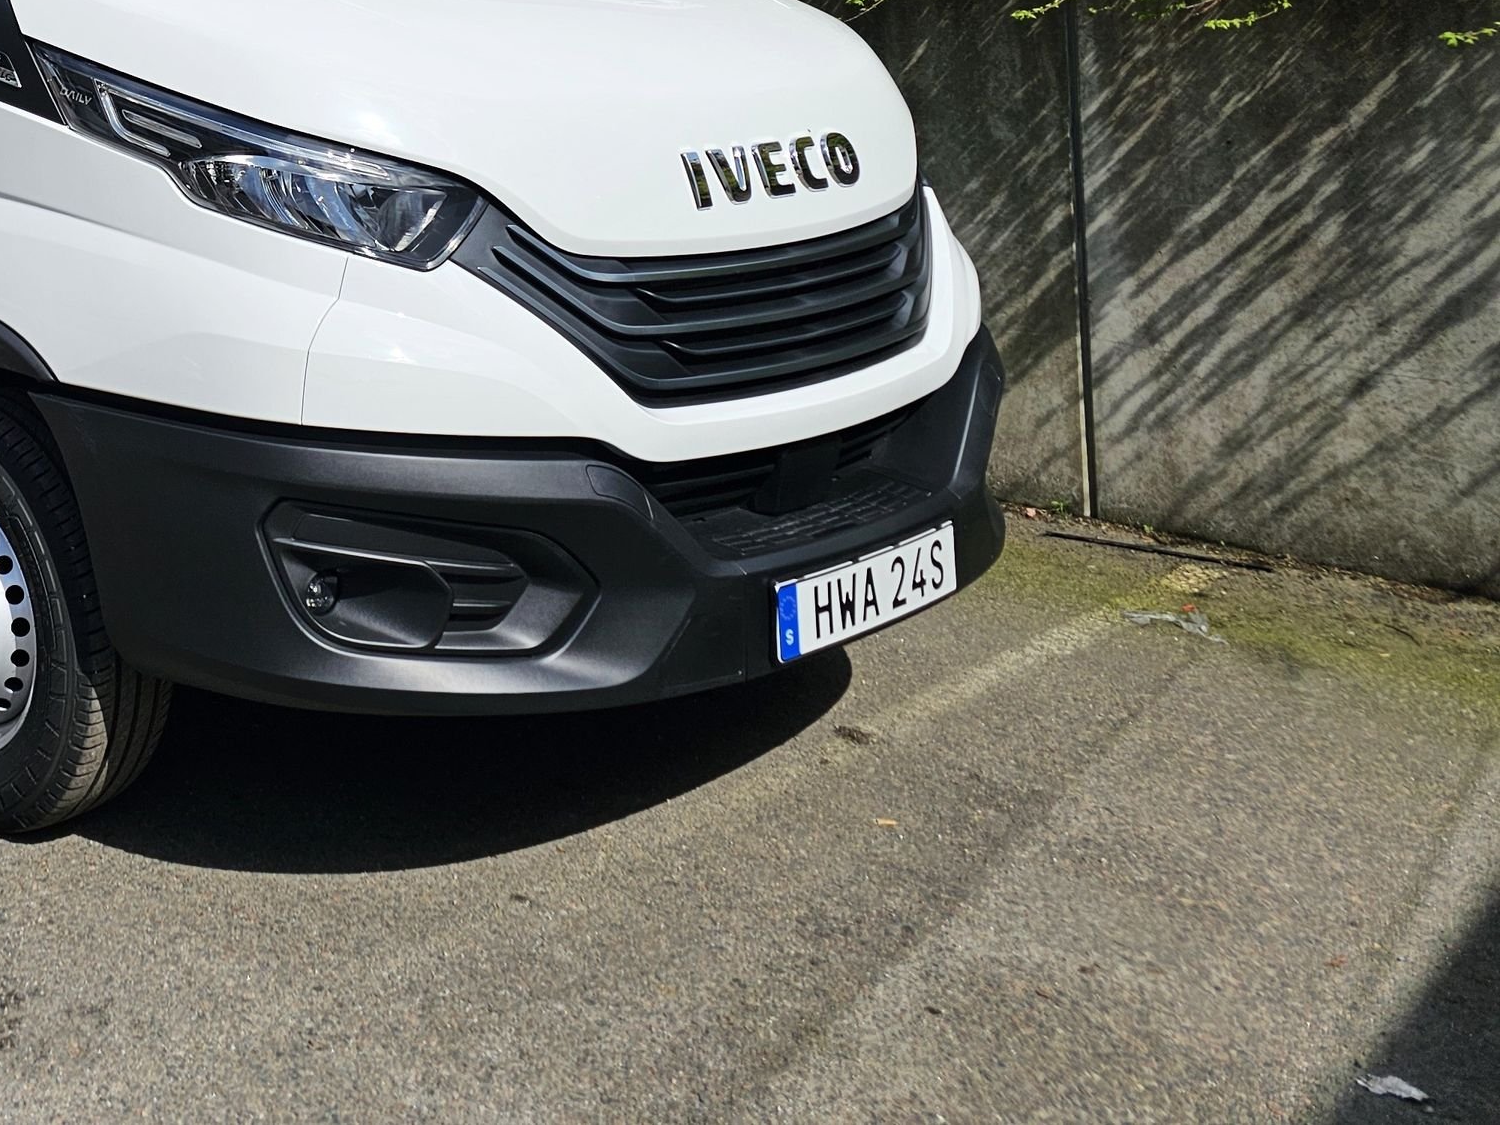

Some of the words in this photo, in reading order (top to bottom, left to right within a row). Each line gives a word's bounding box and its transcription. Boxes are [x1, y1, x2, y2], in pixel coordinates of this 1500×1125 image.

[60, 87, 92, 105] DAILY
[680, 131, 861, 211] IVECO
[813, 567, 880, 639] HWA
[890, 539, 945, 609] 24S
[785, 629, 794, 646] S
